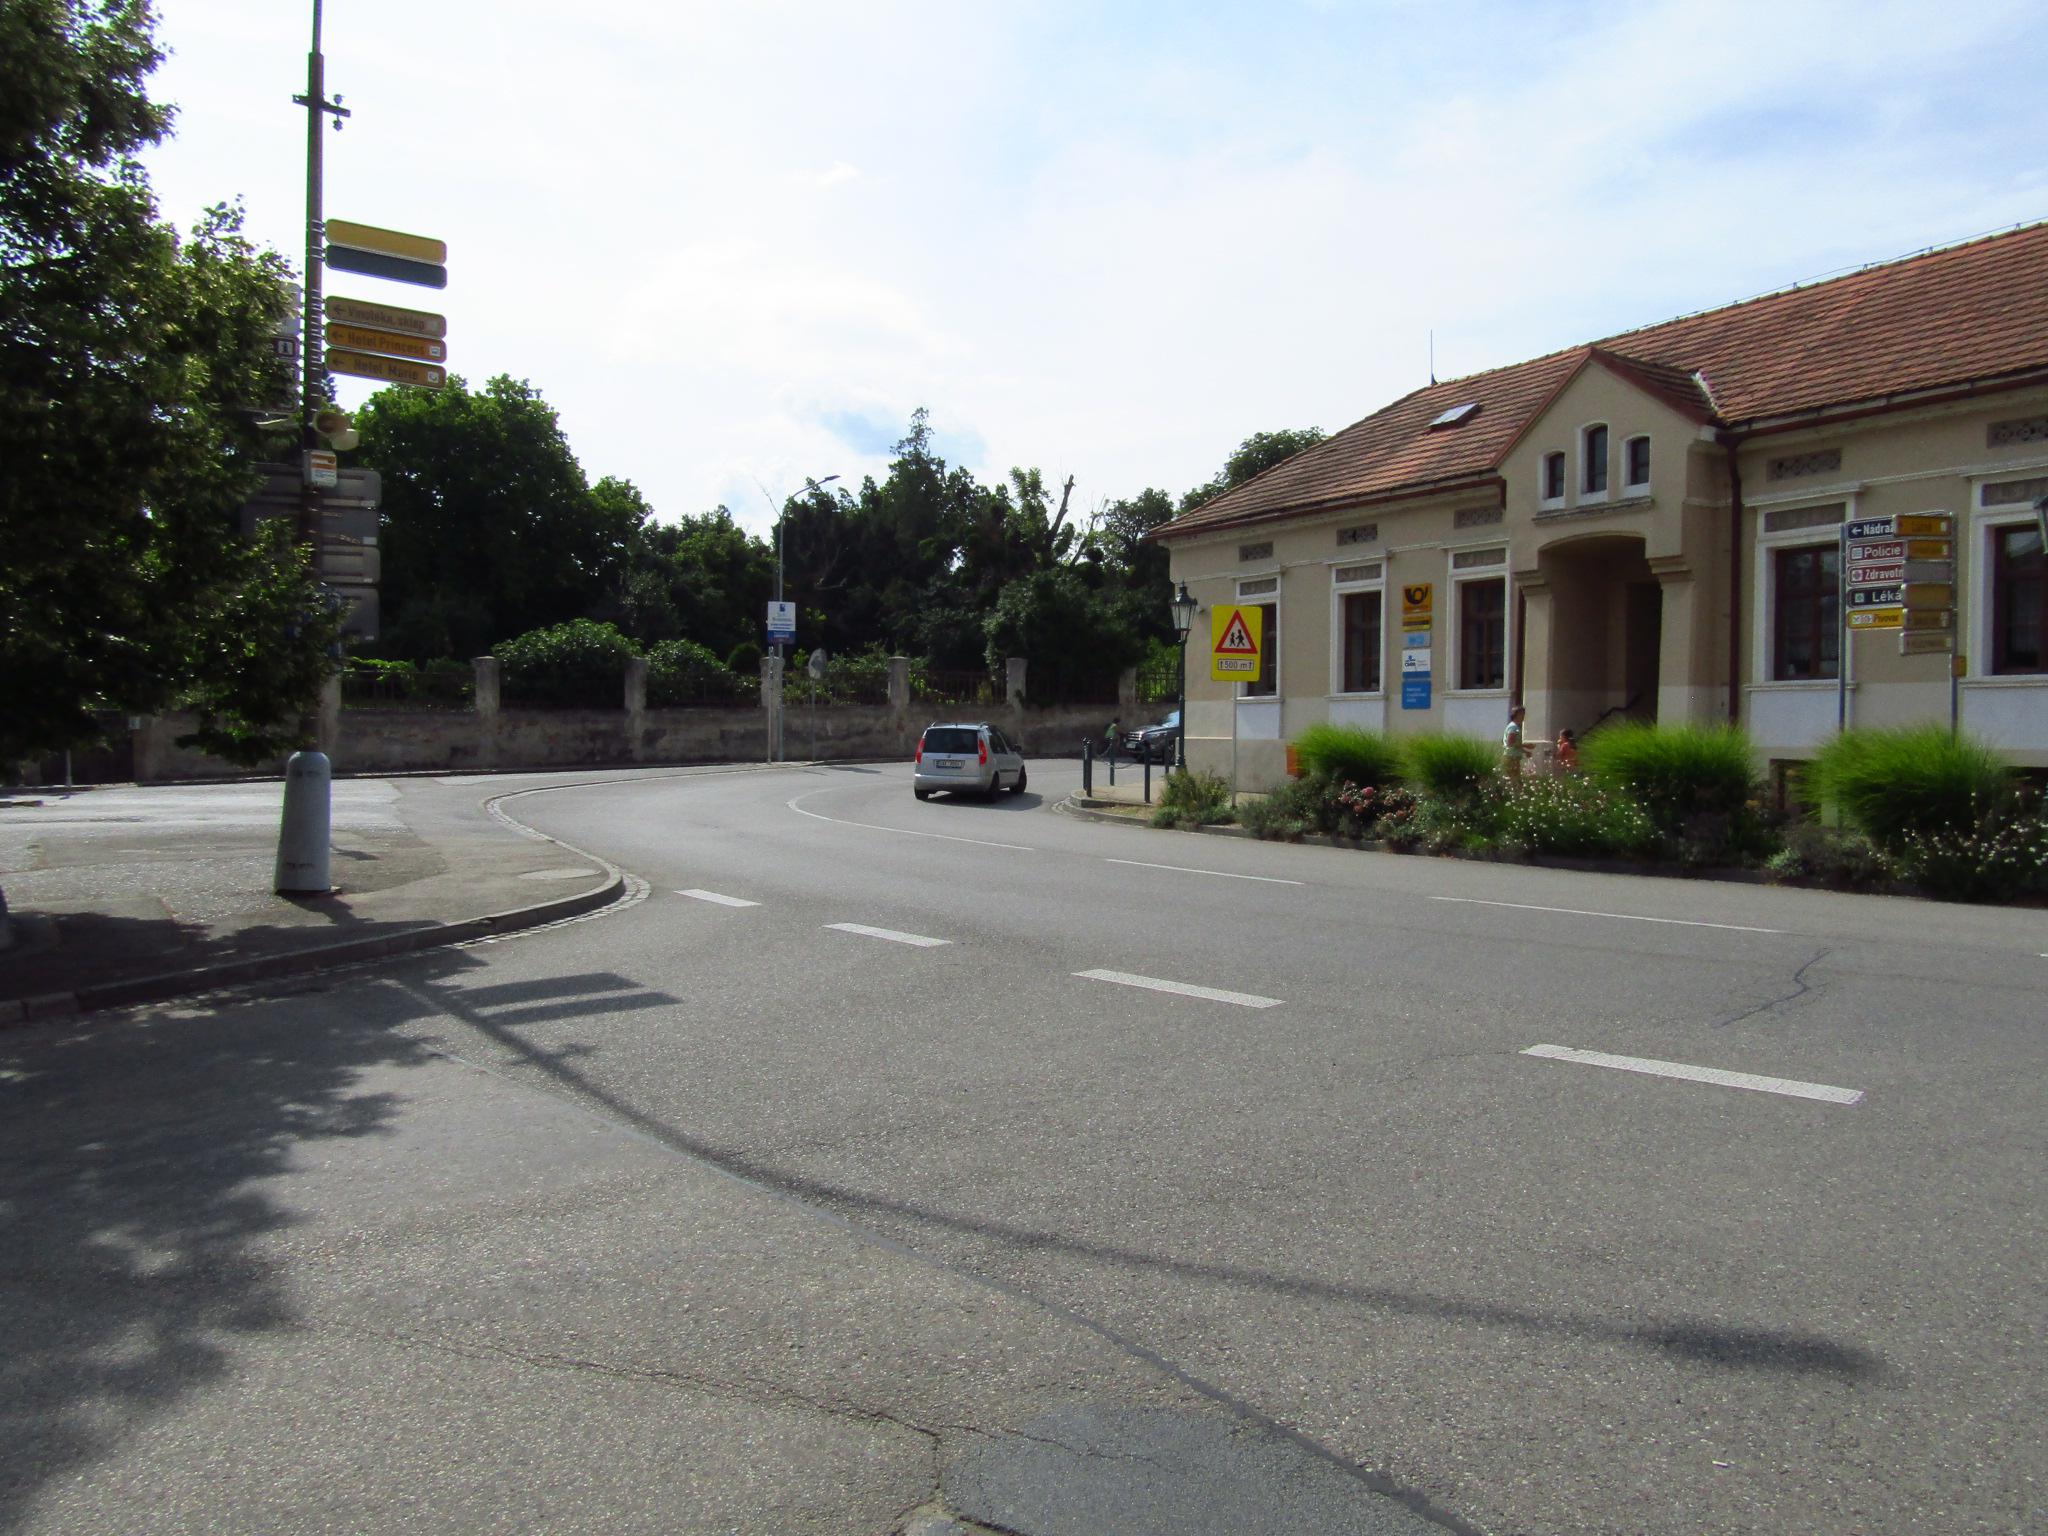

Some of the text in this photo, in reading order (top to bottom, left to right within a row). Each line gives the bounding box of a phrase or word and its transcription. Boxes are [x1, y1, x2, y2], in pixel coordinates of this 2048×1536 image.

[347, 330, 377, 348] Hotel
[354, 358, 383, 375] Hotel
[1864, 546, 1901, 559] Policie
[1224, 660, 1238, 669] 500
